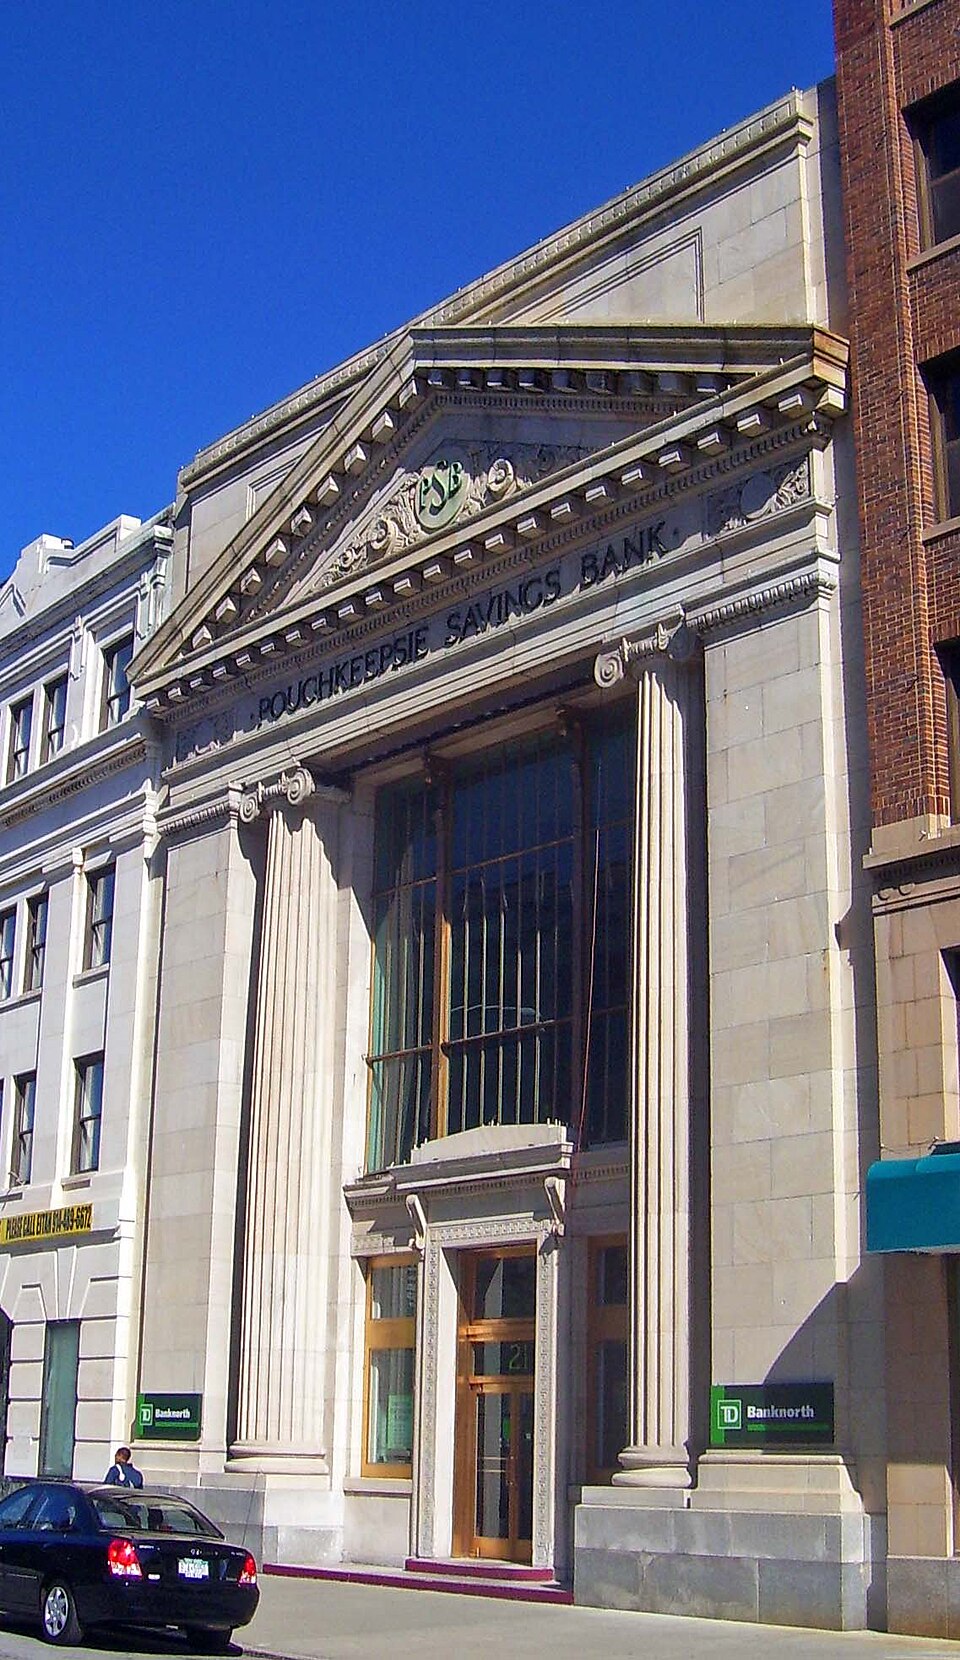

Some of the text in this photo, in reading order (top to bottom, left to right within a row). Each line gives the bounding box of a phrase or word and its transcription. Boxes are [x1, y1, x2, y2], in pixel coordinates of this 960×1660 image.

[419, 460, 463, 516] PSB
[258, 520, 667, 722] POUGHKEEPSIE SAVINGS BANK
[141, 1408, 191, 1422] TD Banknorth
[720, 1404, 814, 1423] TD Banknorth
